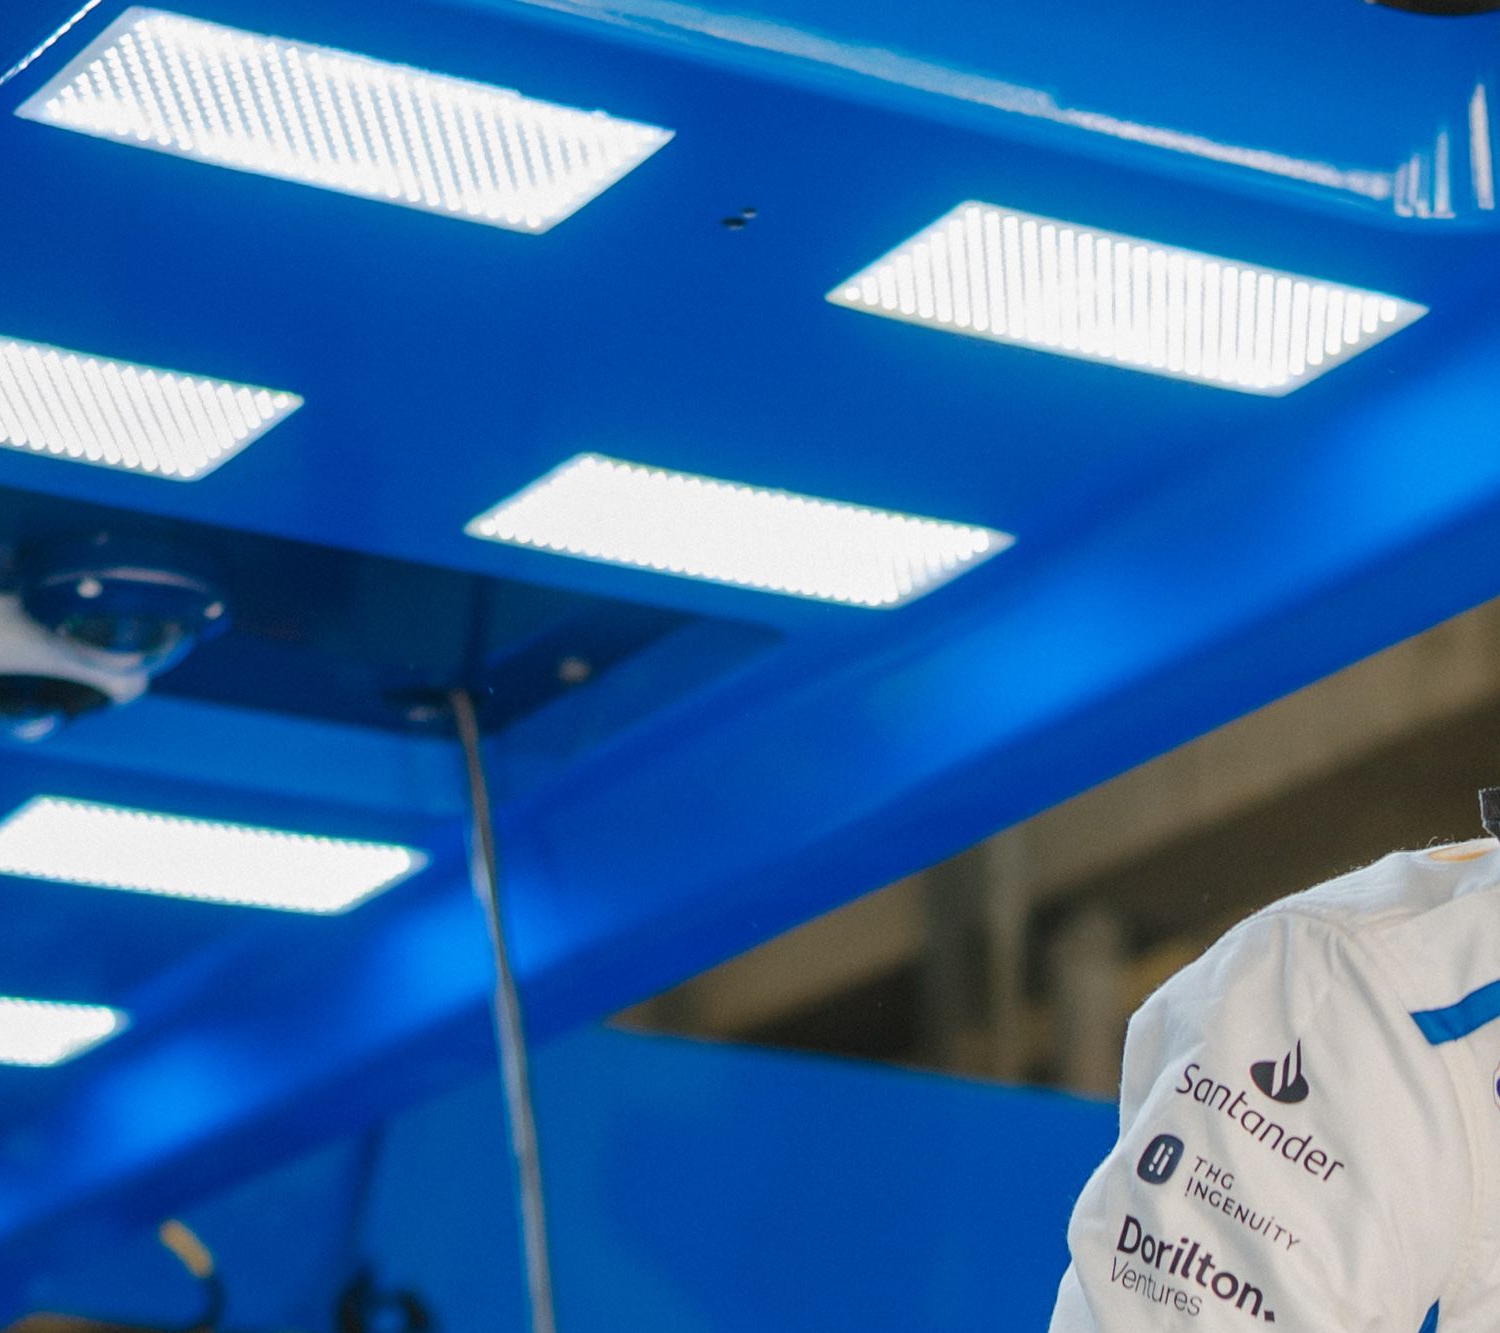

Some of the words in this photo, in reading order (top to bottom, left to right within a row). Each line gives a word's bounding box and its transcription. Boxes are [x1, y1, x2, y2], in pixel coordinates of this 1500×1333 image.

[1174, 1062, 1346, 1184] Santander
[1192, 1155, 1236, 1190] THG
[1109, 1256, 1204, 1317] Ventures
